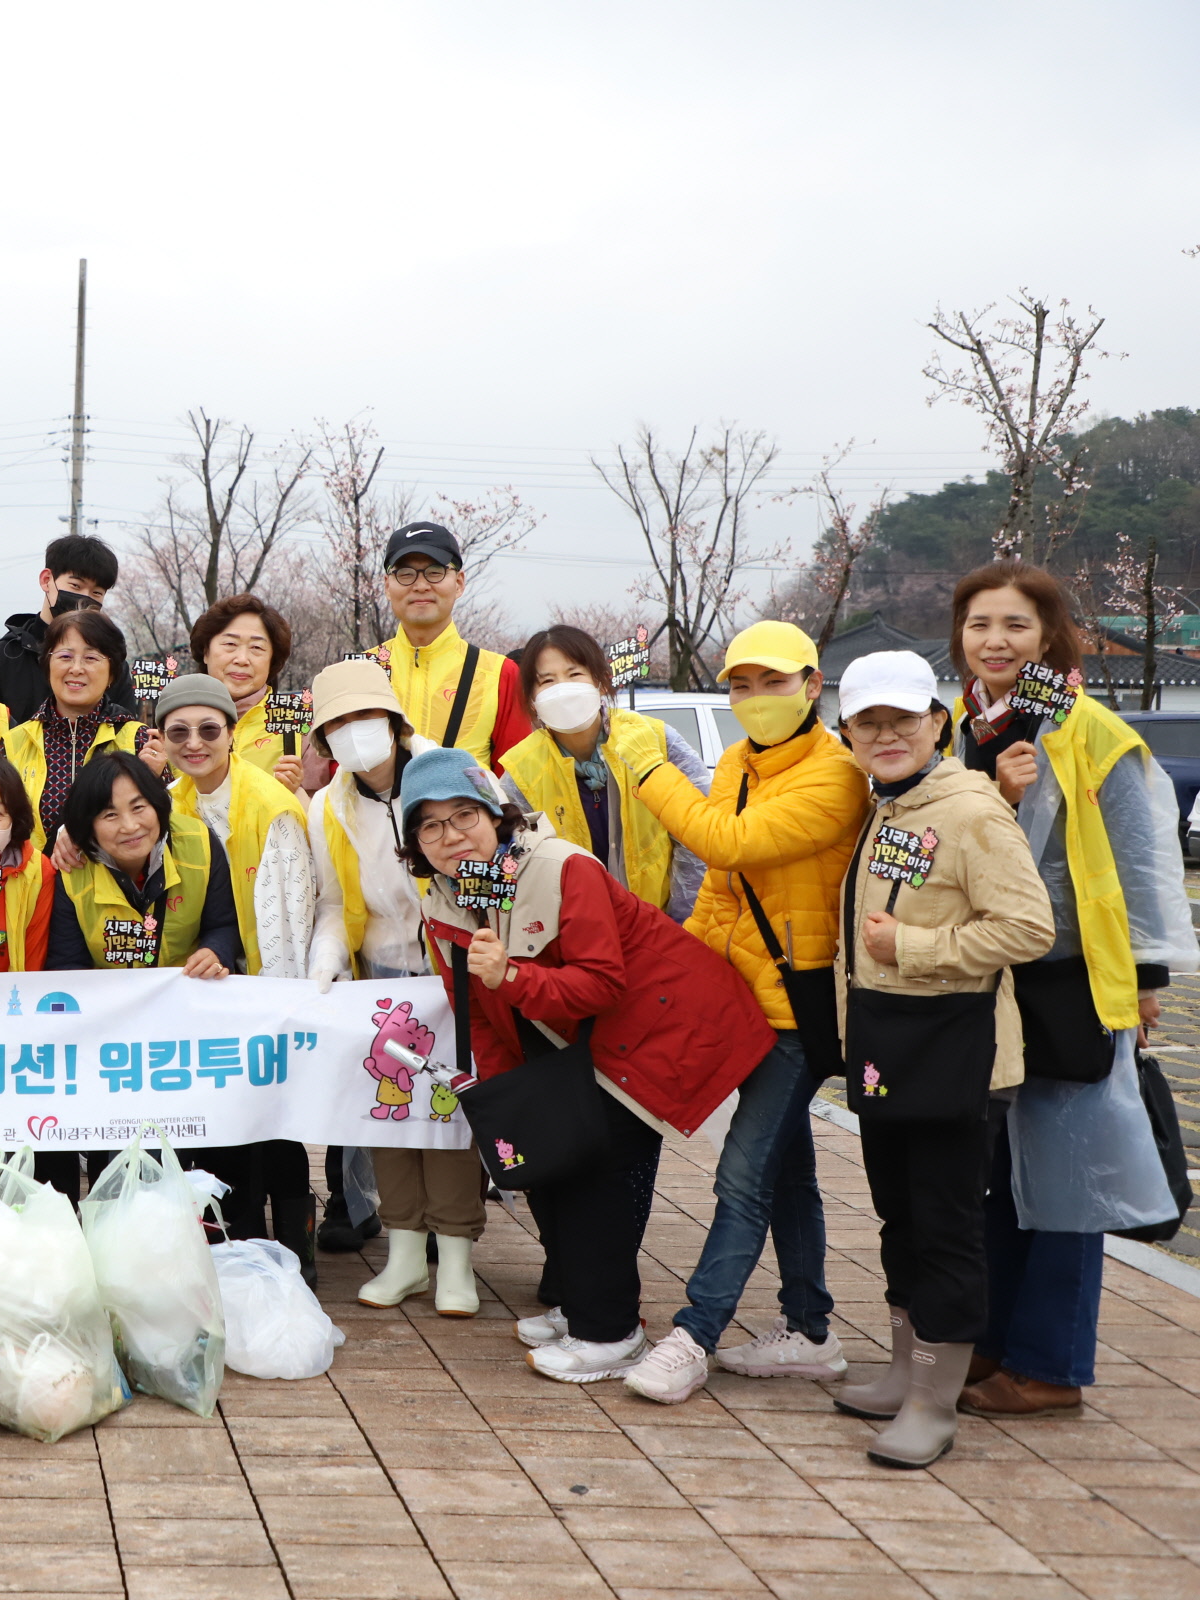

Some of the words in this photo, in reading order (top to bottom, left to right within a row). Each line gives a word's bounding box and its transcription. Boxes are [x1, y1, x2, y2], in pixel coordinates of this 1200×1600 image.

[611, 666, 641, 688] 워킹투어
[1011, 696, 1055, 719] 워킹투어
[266, 722, 301, 734] 워킹투어
[869, 861, 912, 883] 워킹투어
[456, 895, 501, 909] 워킹투어
[106, 951, 144, 963] 워킹투어
[99, 1031, 318, 1093] 워킹투어”
